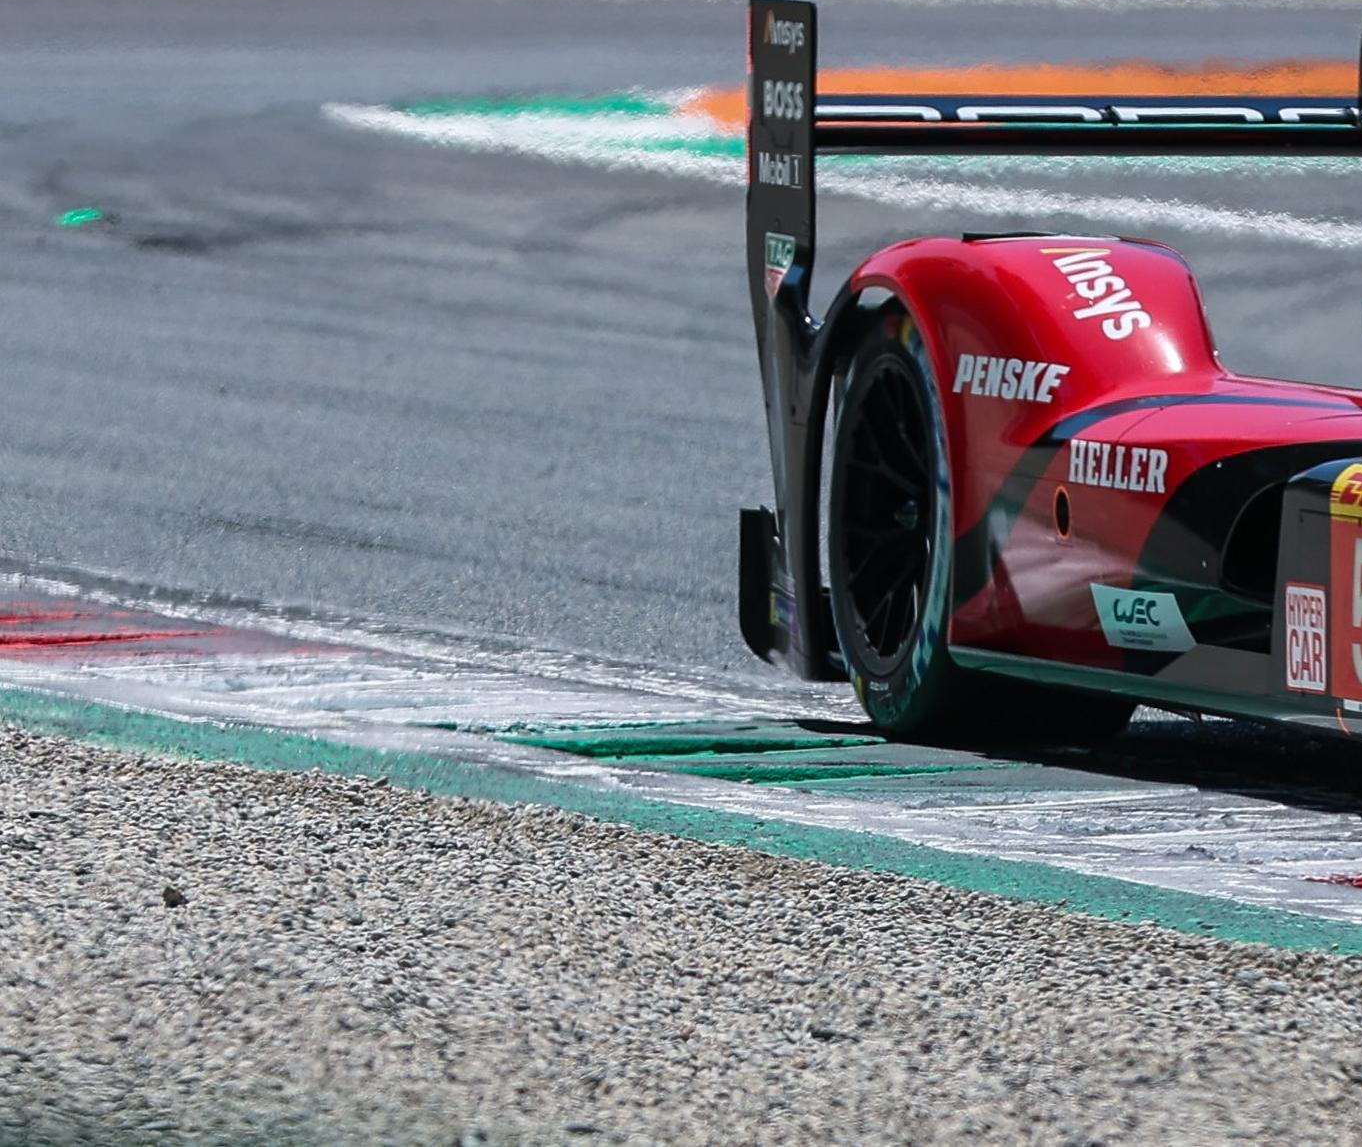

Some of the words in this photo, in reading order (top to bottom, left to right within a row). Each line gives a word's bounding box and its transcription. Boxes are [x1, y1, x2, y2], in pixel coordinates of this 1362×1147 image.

[763, 9, 805, 53] Ansys
[762, 79, 804, 119] BOSS
[758, 151, 790, 186] Mobil
[767, 239, 793, 265] TAG
[1039, 247, 1152, 341] Ansys
[952, 353, 1071, 404] PENSKE
[1068, 438, 1169, 494] HELLER
[1113, 597, 1160, 627] WEC
[1287, 593, 1324, 630] HYPER
[1288, 628, 1324, 684] CAR
